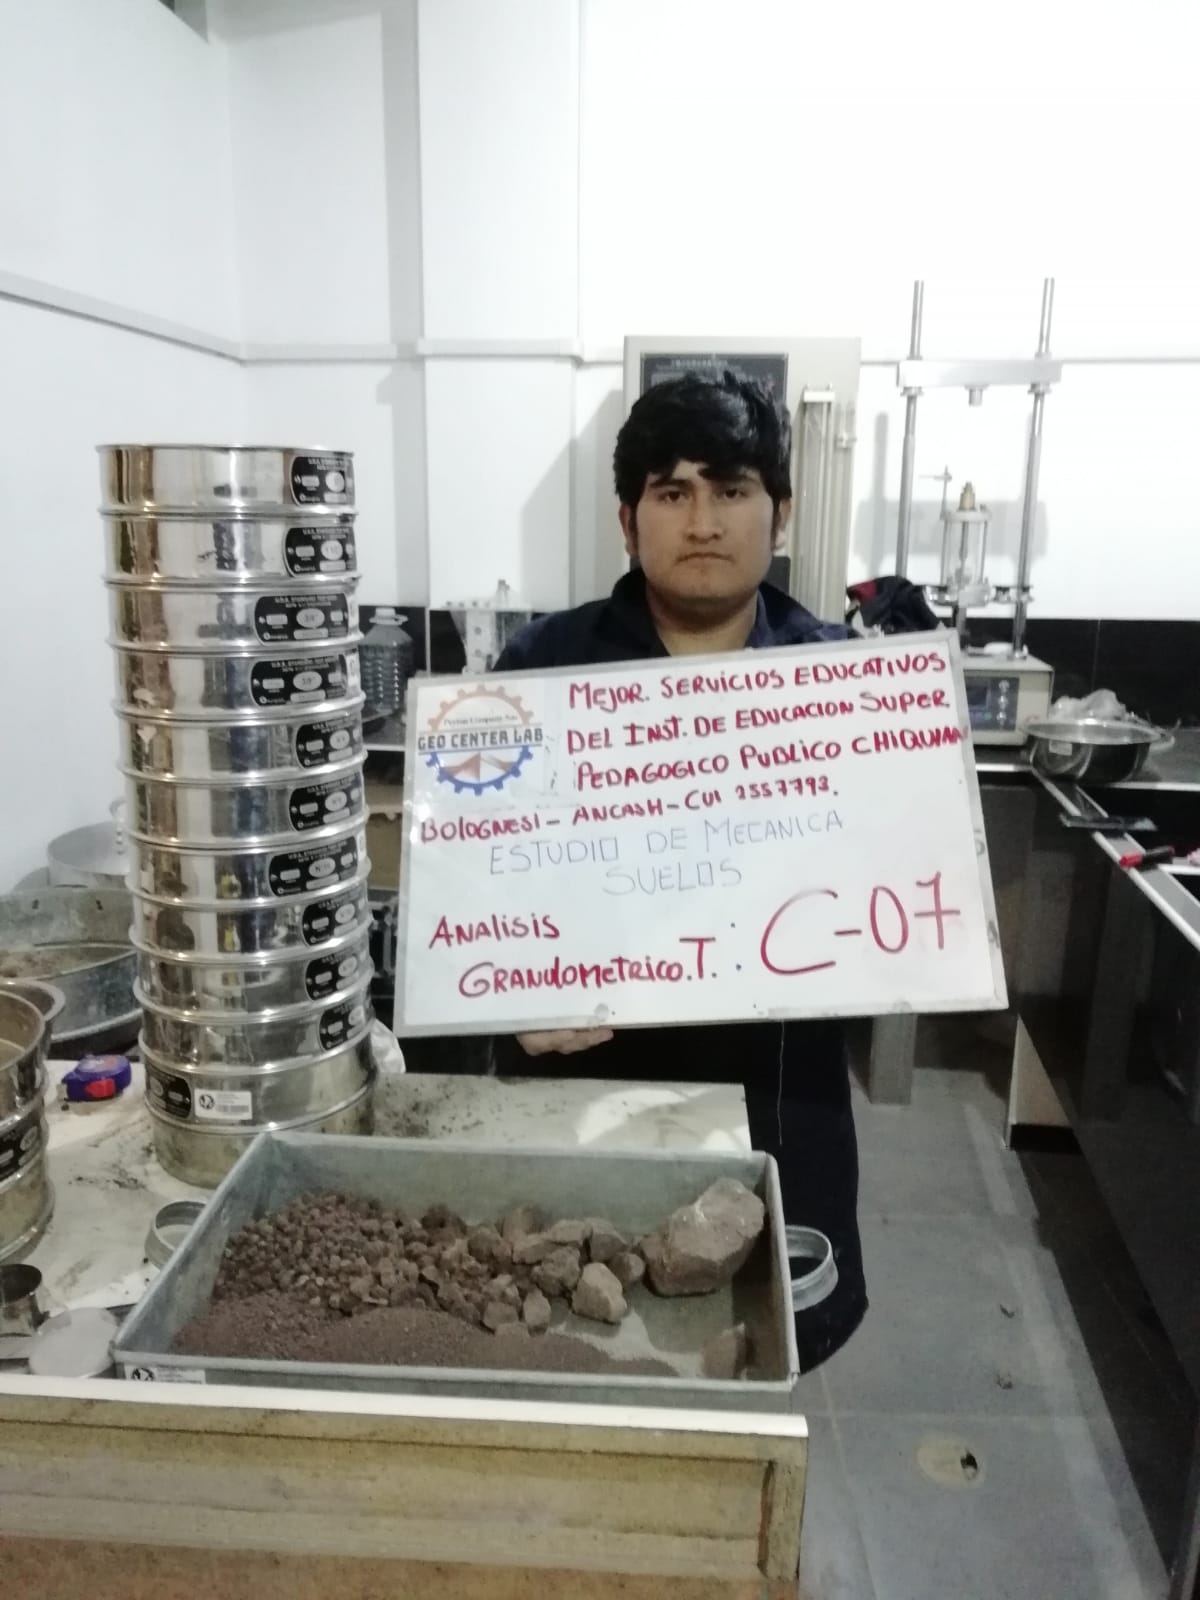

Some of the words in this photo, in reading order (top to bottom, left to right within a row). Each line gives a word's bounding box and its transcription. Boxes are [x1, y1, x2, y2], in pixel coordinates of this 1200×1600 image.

[661, 670, 784, 699] SERVICIOS
[794, 653, 945, 686] EDUCATIVOS
[418, 735, 446, 751] GEO
[452, 731, 507, 747] CENTER
[514, 728, 543, 742] LAB
[567, 728, 612, 755] DEL
[623, 715, 687, 746] INST.
[694, 716, 726, 737] DE
[736, 701, 854, 730] EDUCACION
[578, 754, 729, 793] PEDAGOGICO
[740, 740, 841, 770] PUBLICO
[421, 813, 540, 845] BOLOGNESI
[490, 836, 619, 875] ESTUDIO
[646, 828, 686, 853] DE
[704, 810, 842, 852] MECANICA
[602, 859, 742, 896] SUELOS
[429, 913, 560, 949] ANALISIS
